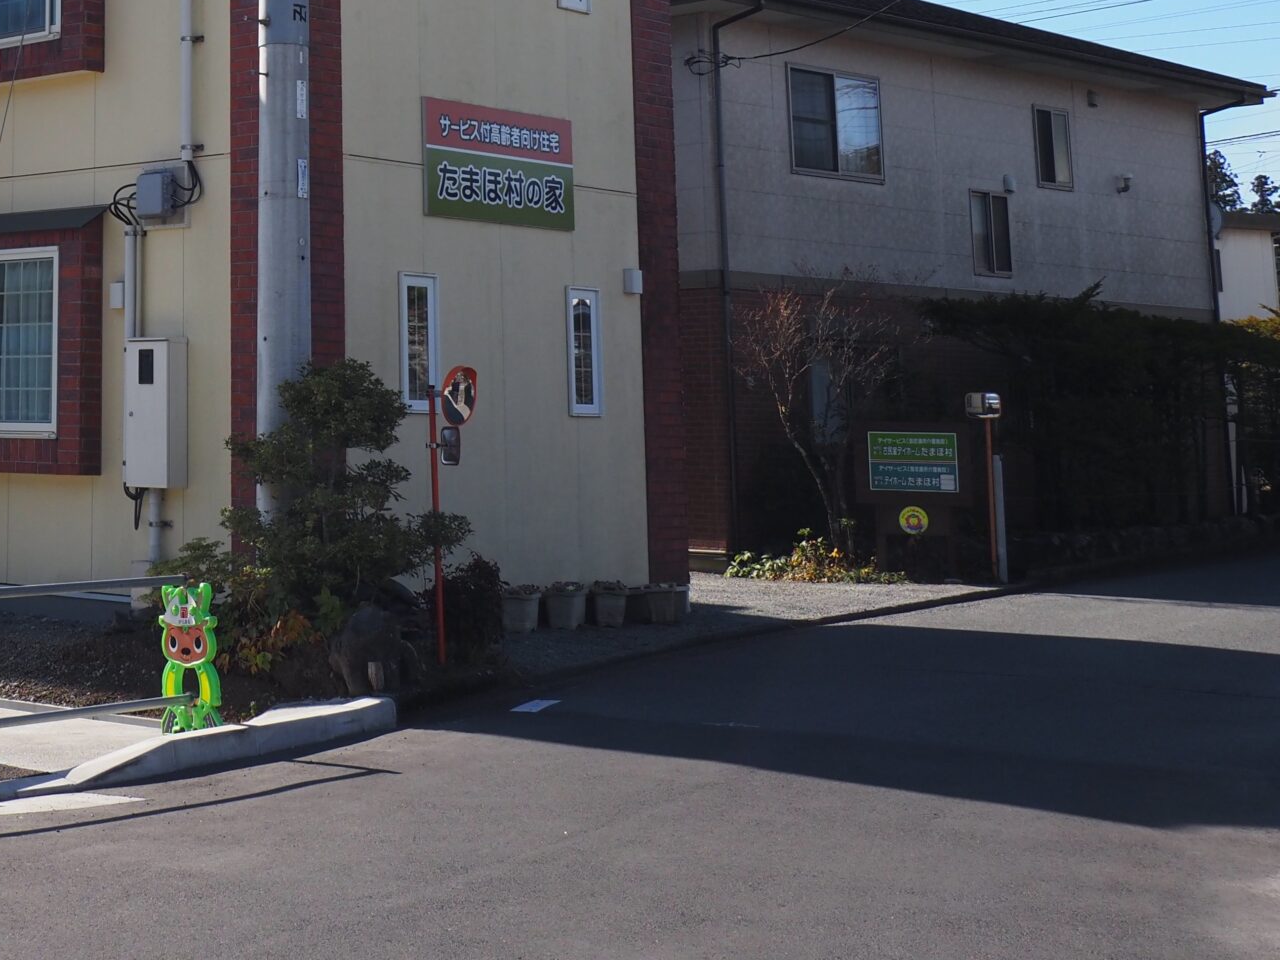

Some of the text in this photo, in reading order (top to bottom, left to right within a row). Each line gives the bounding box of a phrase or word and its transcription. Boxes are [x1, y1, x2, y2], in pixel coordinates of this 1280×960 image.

[439, 114, 560, 153] サービス付高齢者向け住宅
[437, 161, 565, 213] たまほ村の家
